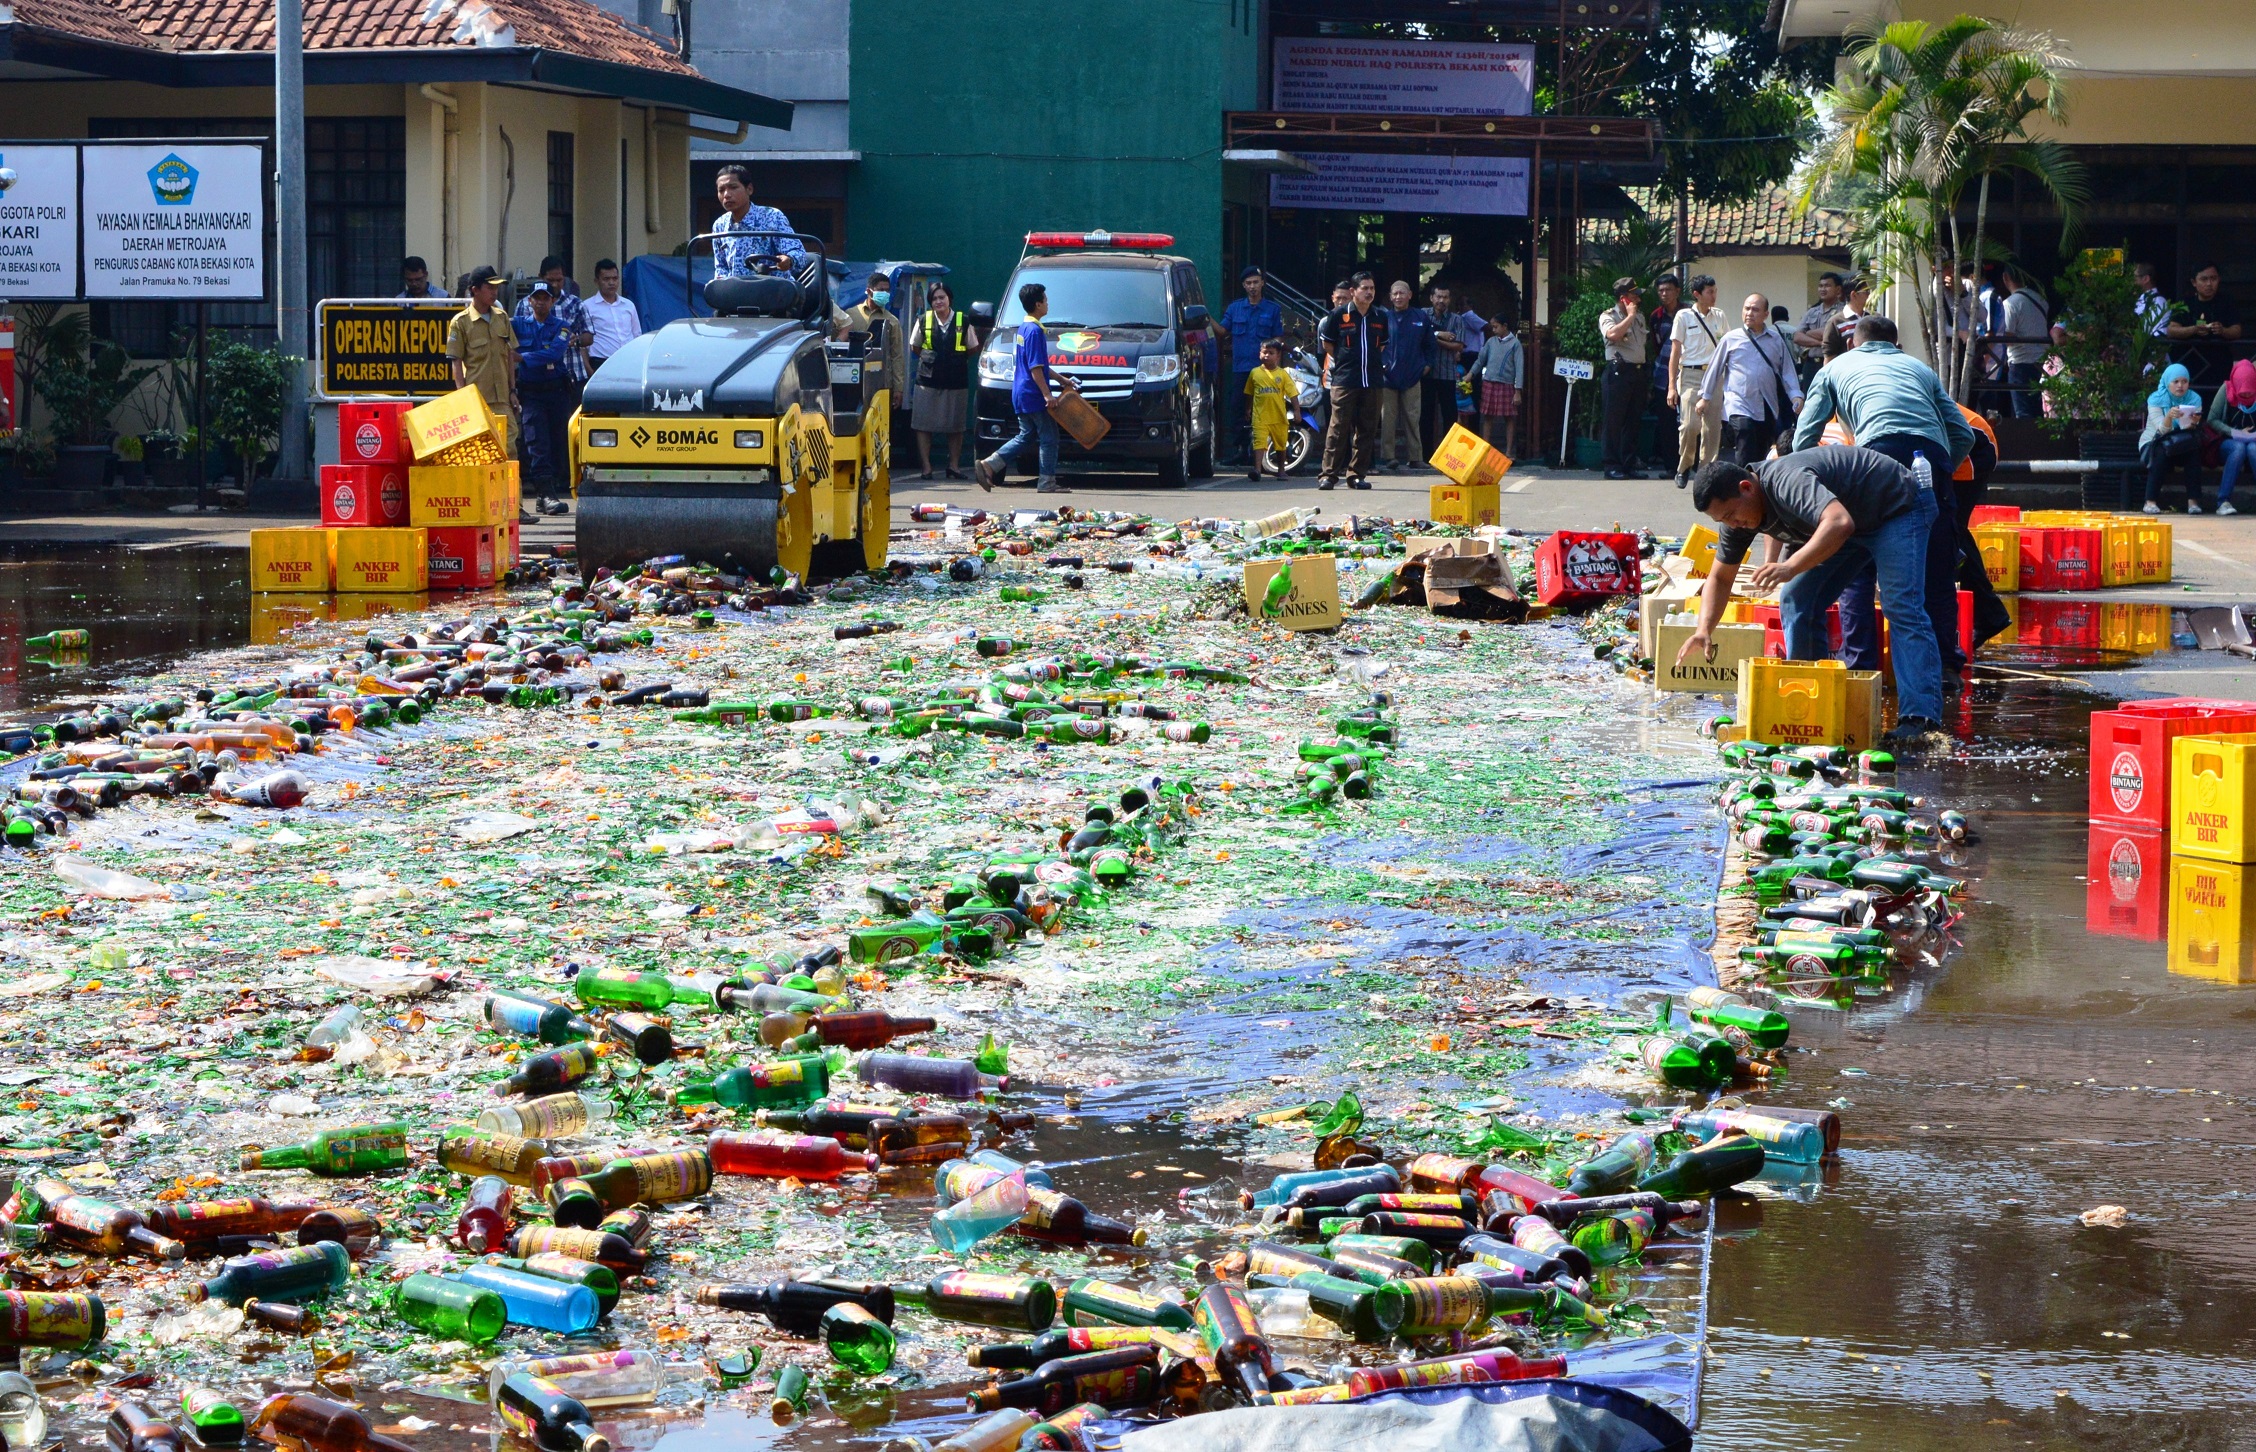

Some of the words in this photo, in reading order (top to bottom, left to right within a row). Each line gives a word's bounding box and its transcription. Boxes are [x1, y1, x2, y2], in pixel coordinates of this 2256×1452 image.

[1289, 46, 1333, 54] AGENDA
[1336, 47, 1388, 56] KEGIATAN
[1392, 48, 1452, 58] RAMADHAN
[1290, 58, 1328, 67] MASJID
[1330, 60, 1366, 68] NURUL
[1369, 61, 1391, 69] HAQ
[1394, 61, 1446, 70] POLRESTA
[1449, 63, 1487, 71] BEKASI
[1490, 64, 1518, 72] KOTA
[0, 206, 34, 220] GGOTA
[37, 206, 66, 219] POLRI
[97, 213, 140, 230] YAYASAN
[143, 213, 182, 230] KEMALA
[185, 212, 251, 229] BHAYANGKARI
[122, 238, 163, 250] DAERAH
[167, 237, 226, 250] METROJAYA
[9, 263, 37, 272] BEKASI
[40, 263, 61, 272] KOTA
[94, 258, 139, 269] PENGURUS
[141, 258, 175, 269] CABANG
[177, 258, 199, 269] KOTA
[201, 258, 231, 269] BEKASI
[233, 258, 254, 269] KOTA
[7, 278, 29, 286] Bekasi
[120, 277, 140, 286] Jalan
[142, 277, 176, 286] Pramuka
[178, 277, 190, 285] No.
[193, 276, 202, 285] 79
[204, 276, 230, 285] Bekasi
[335, 320, 396, 354] OPERASI
[336, 363, 399, 380] POLRESTA
[403, 363, 449, 380] BEKASI
[425, 414, 470, 439] ANKER
[438, 427, 462, 442] BIR
[657, 430, 718, 444] BOMAG
[1444, 453, 1466, 470] ANKER
[1445, 462, 1458, 472] BIR
[382, 491, 401, 499] BINTANG
[425, 497, 471, 507] ANKER
[438, 508, 460, 518] BIR
[266, 561, 313, 572] ANKER
[352, 561, 400, 572] ANKER
[1573, 561, 1617, 575] BINTANG
[2057, 561, 2087, 569] BINTANG
[2110, 561, 2131, 570] ANKER
[2136, 560, 2163, 569] ANKER
[279, 572, 302, 583] BIR
[365, 572, 389, 583] BIR
[1769, 723, 1824, 737] ANKER
[2112, 776, 2141, 789] BINTANG
[2185, 811, 2228, 829] ANKER
[2197, 827, 2218, 843] BIR
[633, 1161, 645, 1195] BRANDY
